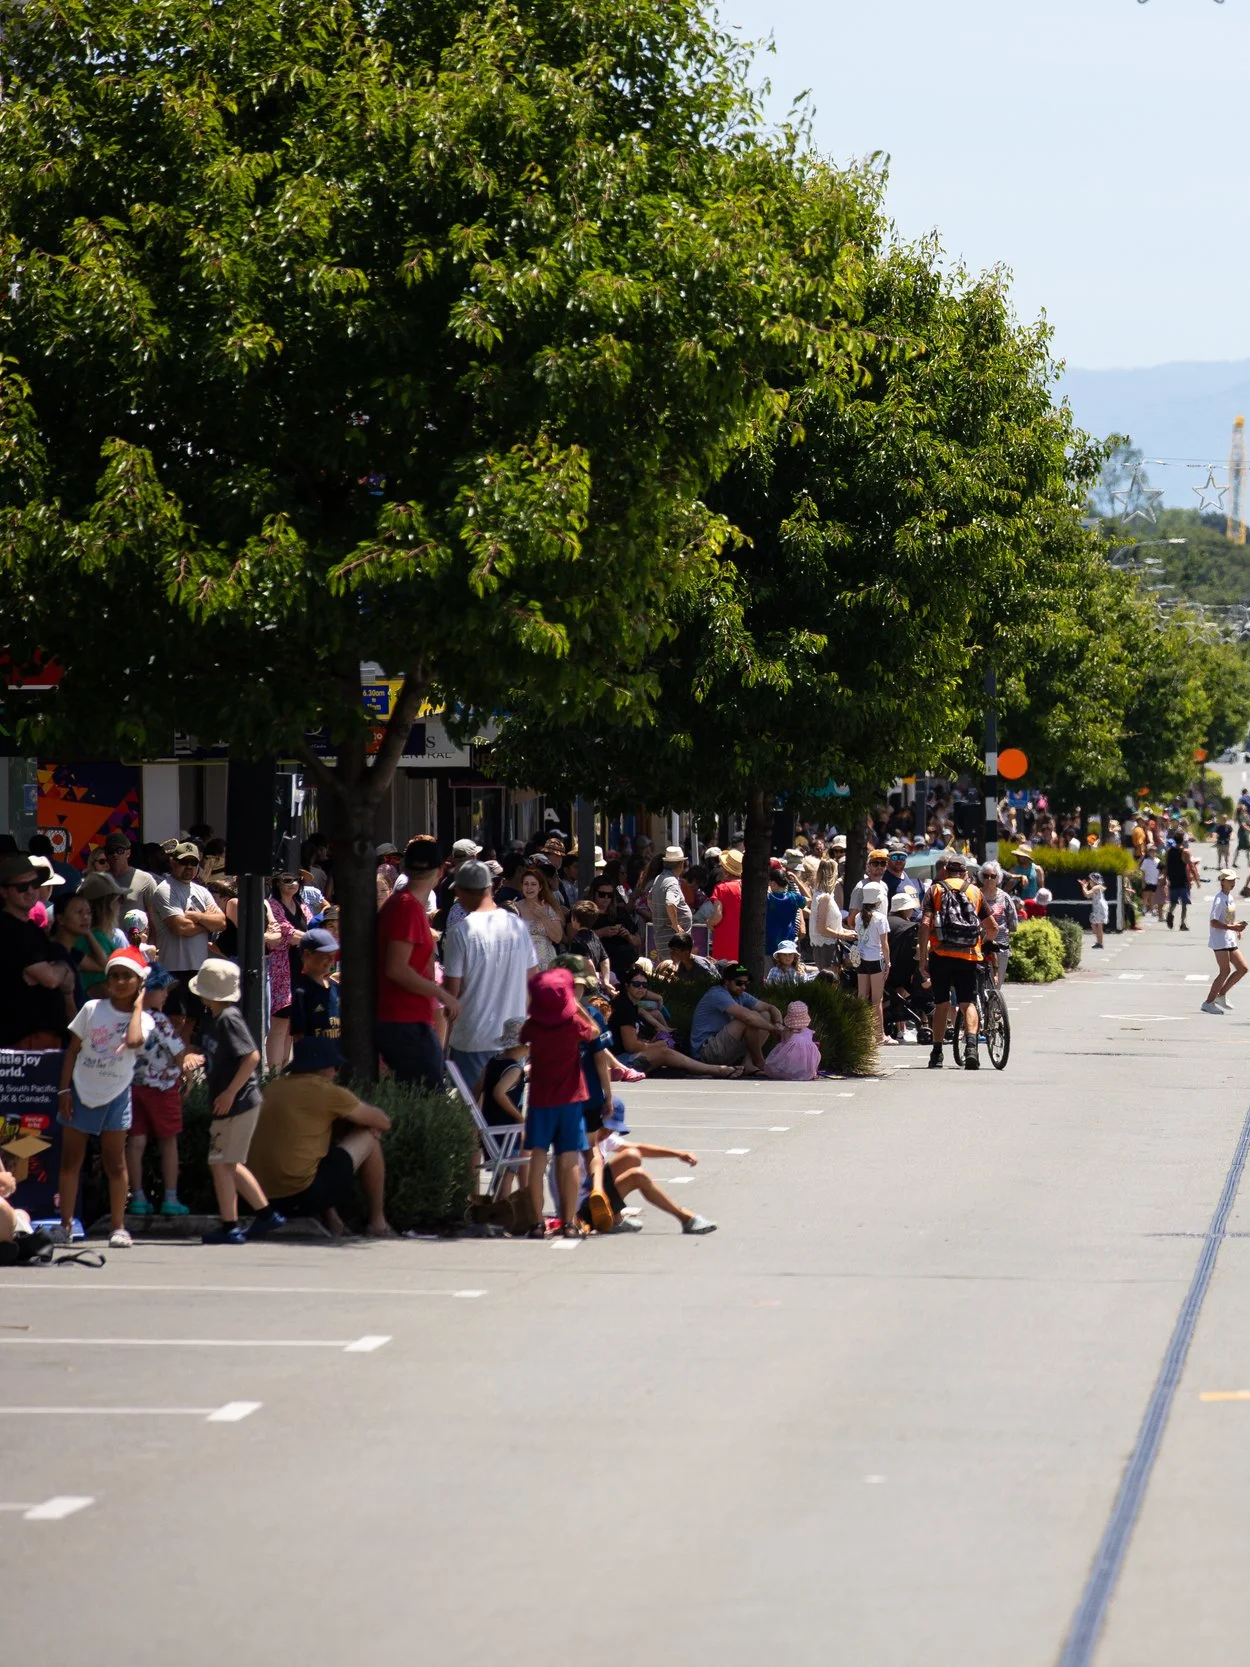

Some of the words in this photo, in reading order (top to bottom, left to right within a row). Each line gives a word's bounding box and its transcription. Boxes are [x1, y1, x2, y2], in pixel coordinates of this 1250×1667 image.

[22, 1054, 42, 1067] joy
[6, 1084, 30, 1093] South
[11, 1095, 19, 1103] &
